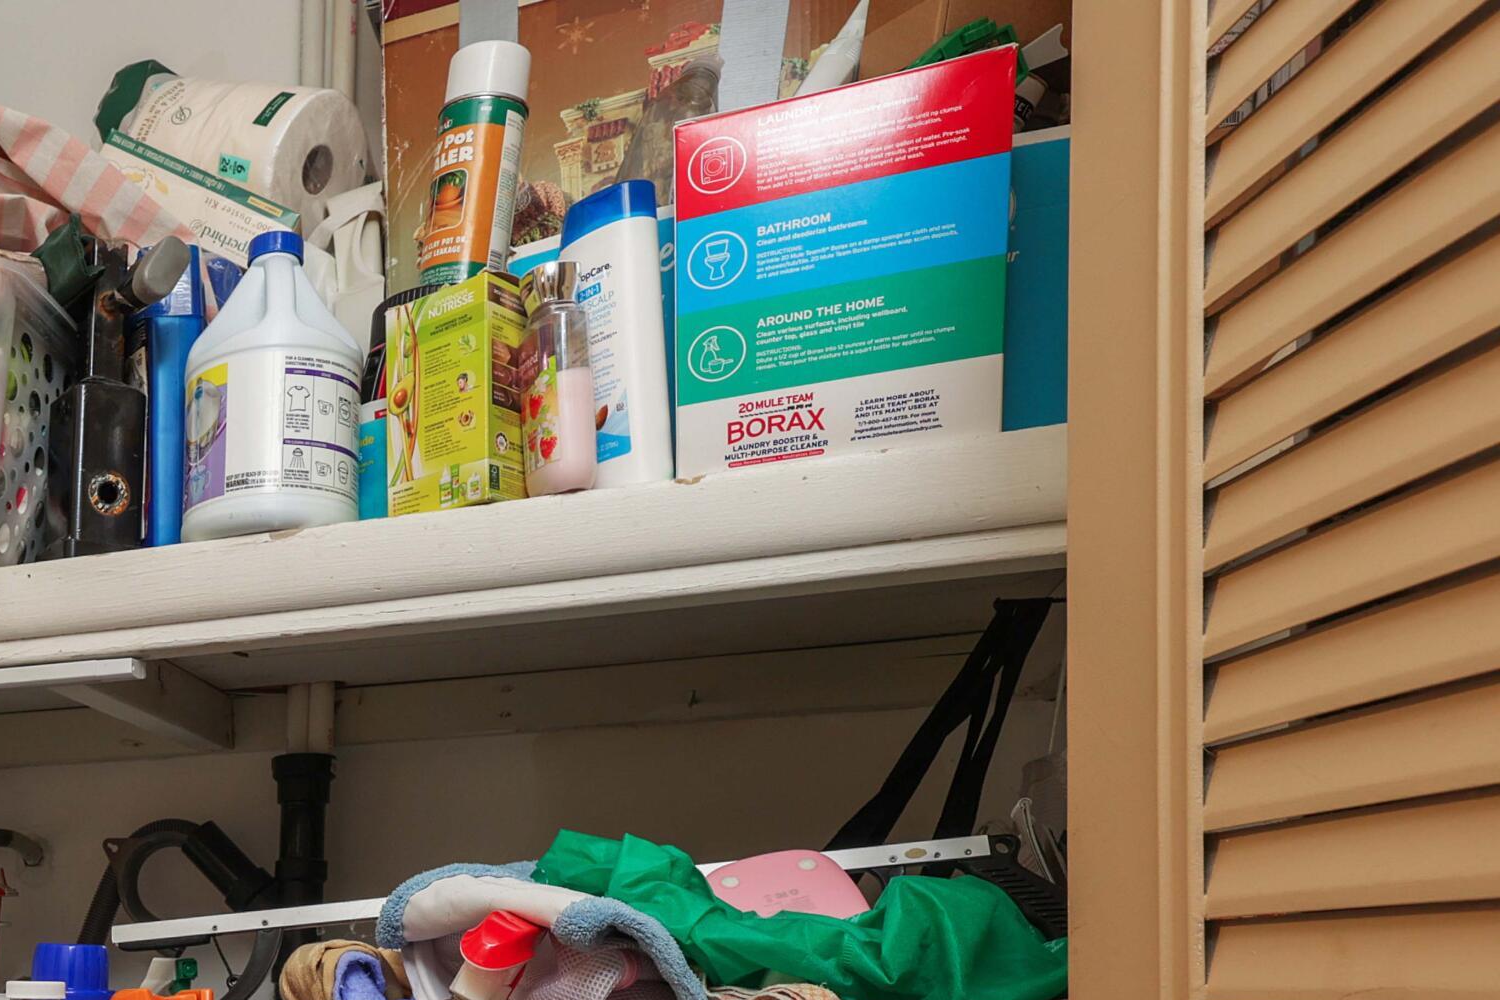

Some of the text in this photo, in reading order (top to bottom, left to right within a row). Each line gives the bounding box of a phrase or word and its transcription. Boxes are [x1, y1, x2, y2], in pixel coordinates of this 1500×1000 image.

[757, 102, 822, 127] LAUNDRY
[444, 128, 474, 149] Pot
[219, 157, 229, 173] 24
[235, 161, 246, 174] 6
[204, 196, 221, 210] Kit
[220, 201, 251, 225] Duster
[756, 218, 867, 246] Clean and deodorize bathrooms
[757, 212, 832, 237] BATHROOM
[200, 226, 249, 253] perbird
[580, 263, 612, 283] opCare.
[428, 290, 476, 319] NUTRISSE
[757, 295, 884, 328] AROUND THE HOME
[756, 305, 907, 338] Clean various surfaces, including wallboard,
[756, 320, 864, 346] counter top, glass and vinyl tile
[738, 391, 813, 413] 20 MULE TEAM
[860, 389, 935, 406] LEARN MORE ABOUT
[914, 394, 940, 402] BORAX
[727, 407, 825, 444] BORAX
[724, 439, 828, 461] MULTI-PURPOSE CLEANER
[732, 440, 770, 452] LAUNDRY
[772, 434, 810, 446] BOOSTER
